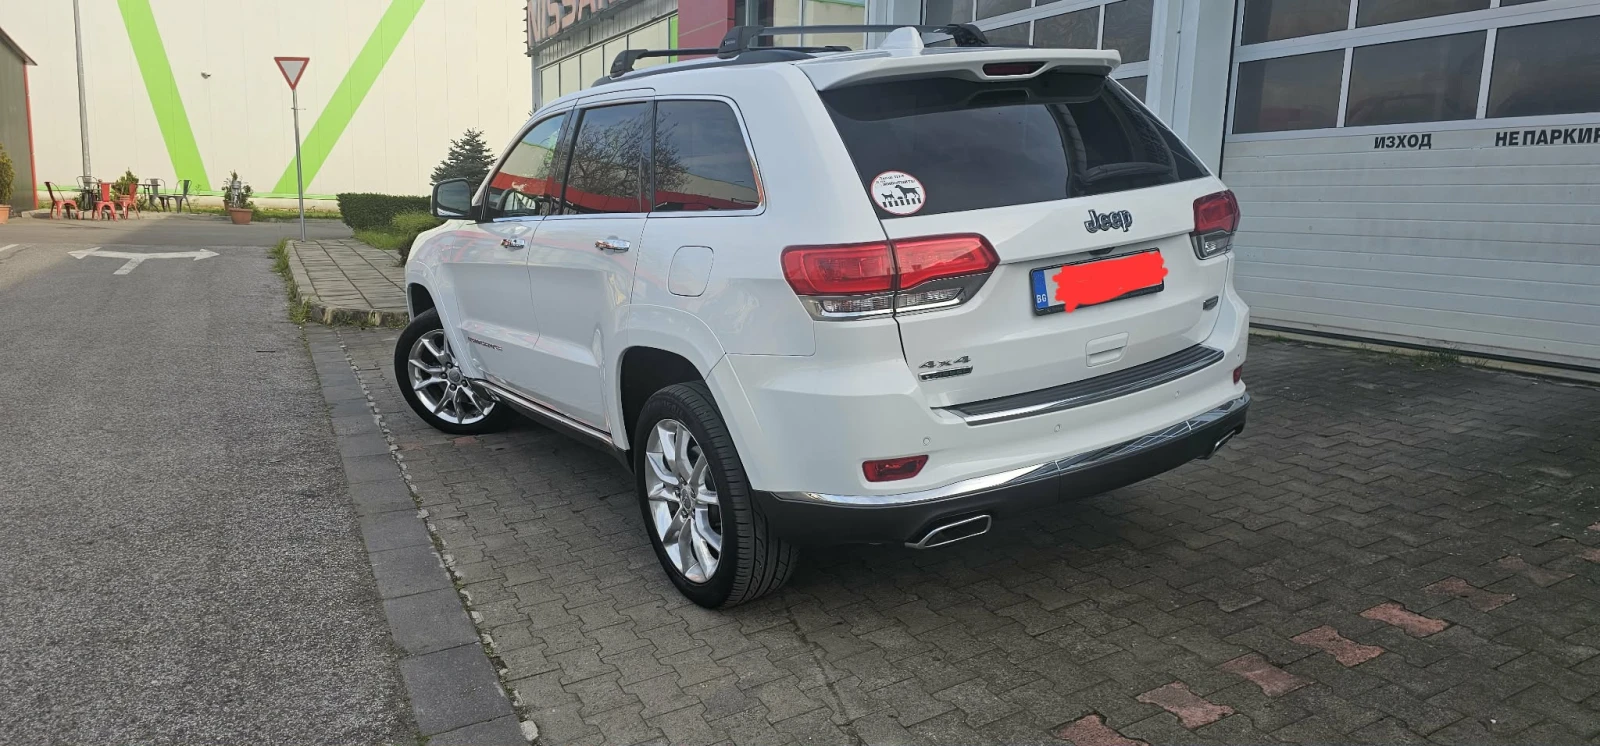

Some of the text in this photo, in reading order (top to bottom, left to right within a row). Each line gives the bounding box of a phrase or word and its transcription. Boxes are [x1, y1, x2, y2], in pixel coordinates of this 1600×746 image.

[1374, 133, 1432, 150] ИЗХОД
[1495, 131, 1520, 147] НЕ
[1084, 209, 1133, 233] Jeep
[1036, 294, 1047, 303] BG
[919, 355, 971, 368] 4x4
